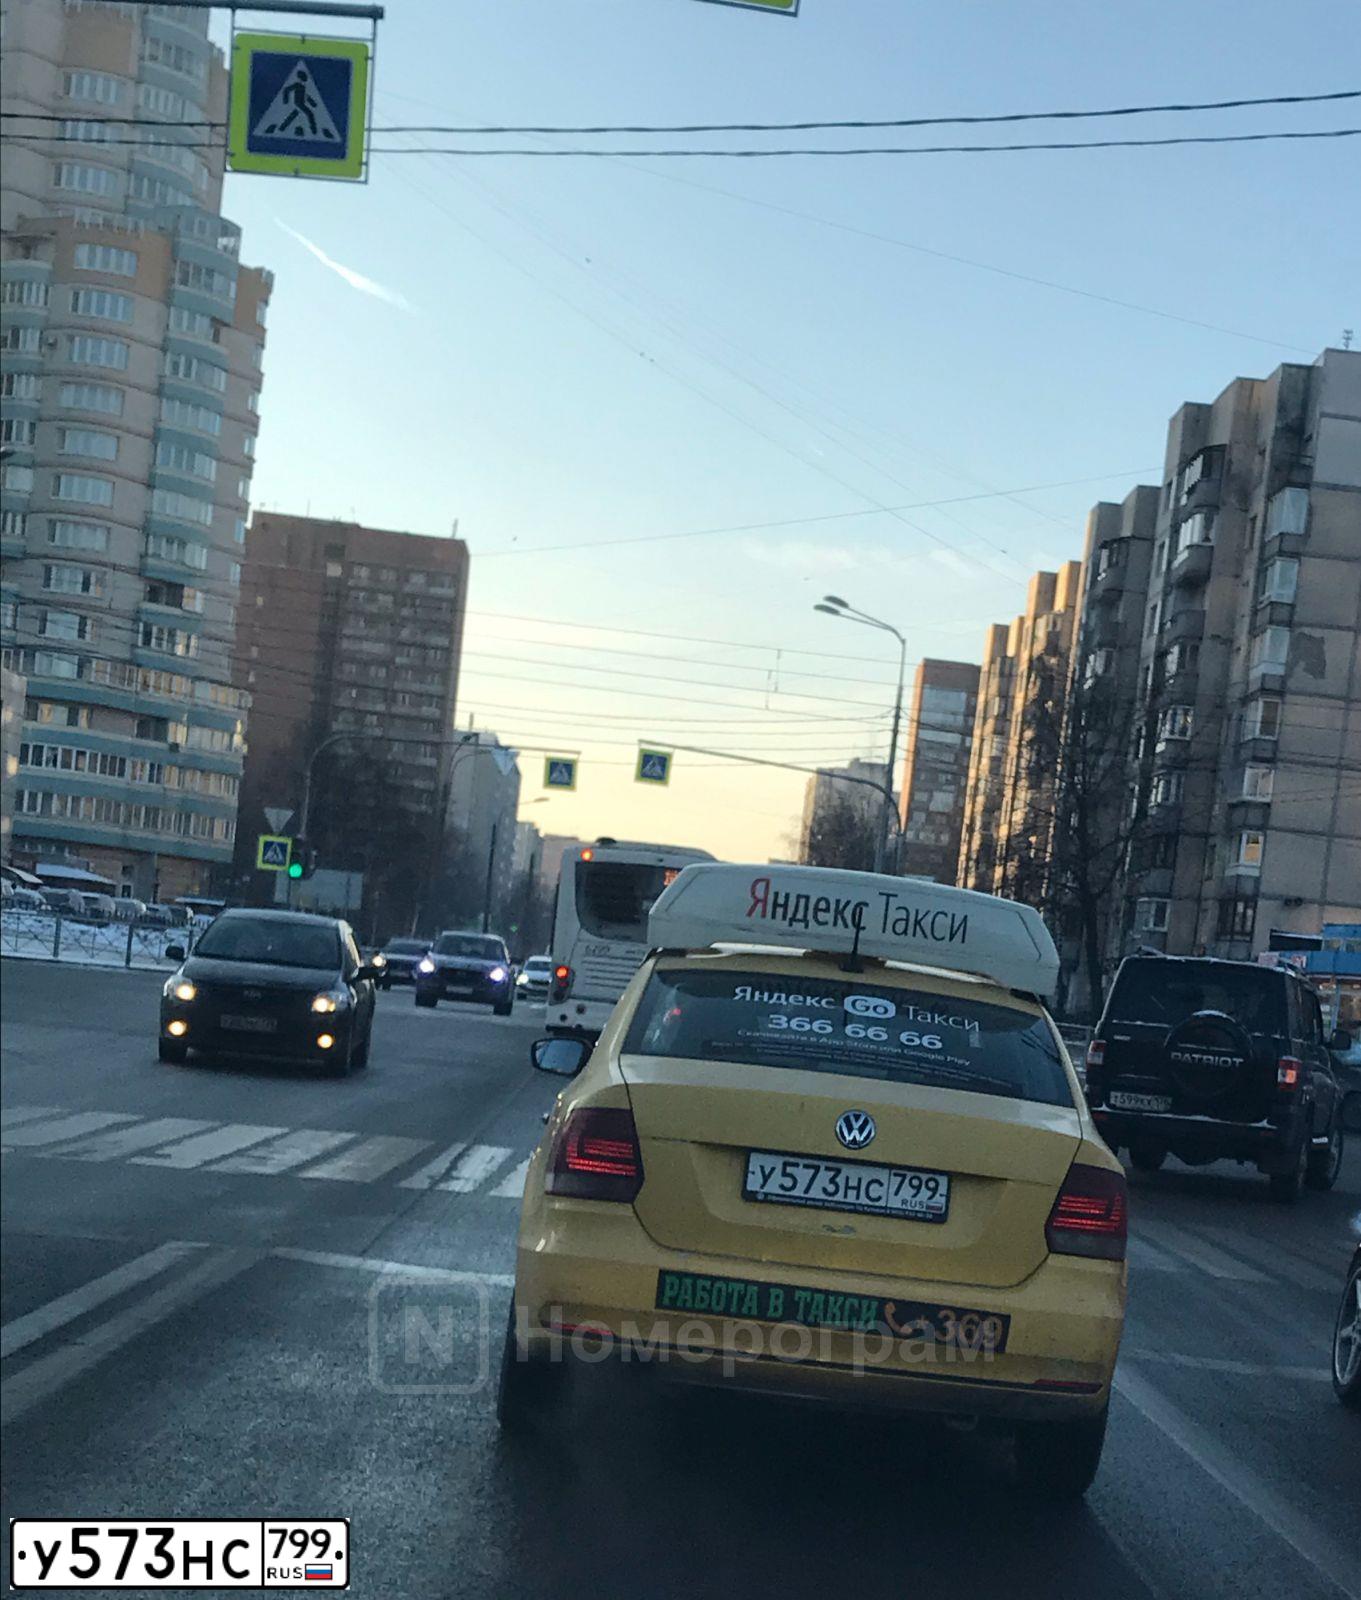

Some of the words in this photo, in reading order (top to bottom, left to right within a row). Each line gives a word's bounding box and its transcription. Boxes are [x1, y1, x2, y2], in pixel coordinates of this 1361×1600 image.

[745, 877, 870, 931] Яндекс
[878, 891, 969, 944] Такси
[733, 985, 837, 1009] Яндекс
[849, 997, 891, 1016] Go
[902, 1003, 980, 1032] Такси
[767, 1014, 834, 1034] 366
[844, 1023, 889, 1041] 66
[899, 1031, 943, 1050] 66
[1170, 1051, 1245, 1068] PATRIOT
[758, 1160, 885, 1203] У573НС
[892, 1171, 940, 1201] 799
[901, 1198, 925, 1210] RUS
[661, 1274, 758, 1316] РАБОТА
[766, 1287, 785, 1319] В
[794, 1288, 879, 1330] ТАКСИ
